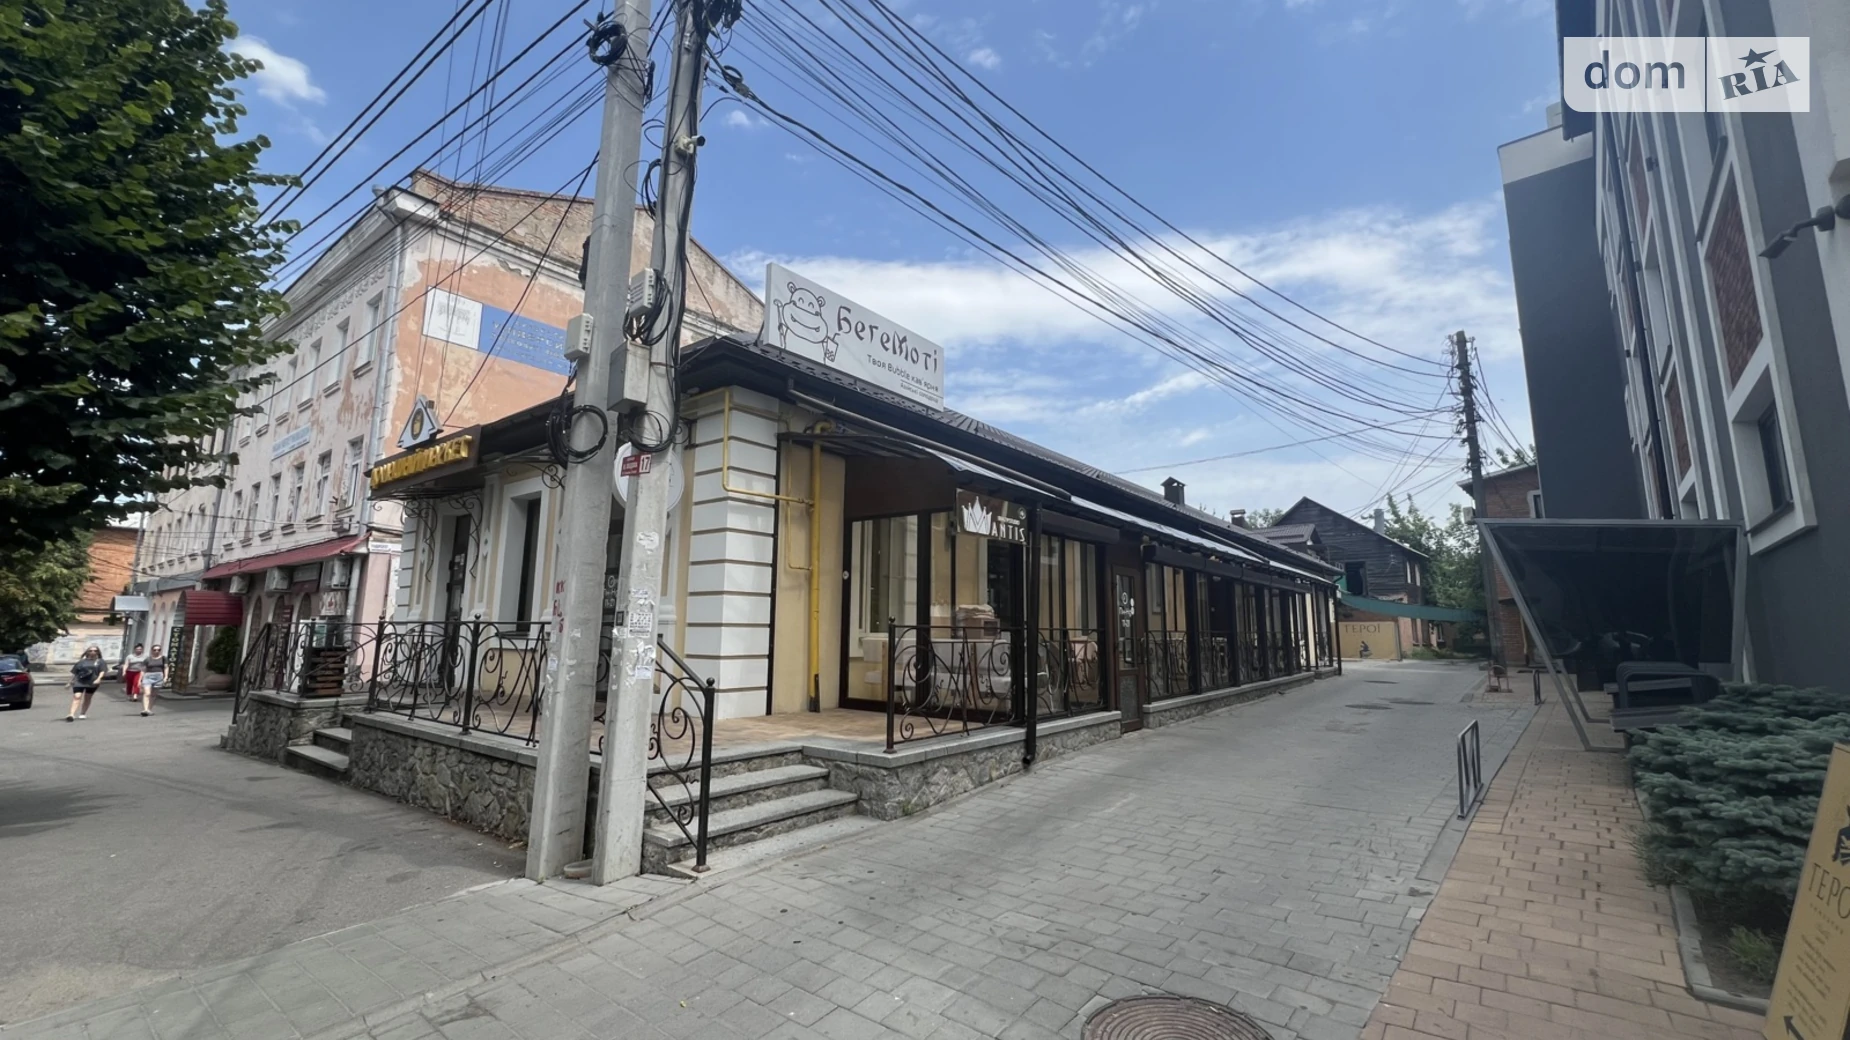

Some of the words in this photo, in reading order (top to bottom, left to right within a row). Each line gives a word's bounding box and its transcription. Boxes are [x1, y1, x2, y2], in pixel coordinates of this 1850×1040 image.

[867, 354, 886, 370] Твоя
[887, 362, 911, 381] Bubble
[641, 456, 651, 471] 17
